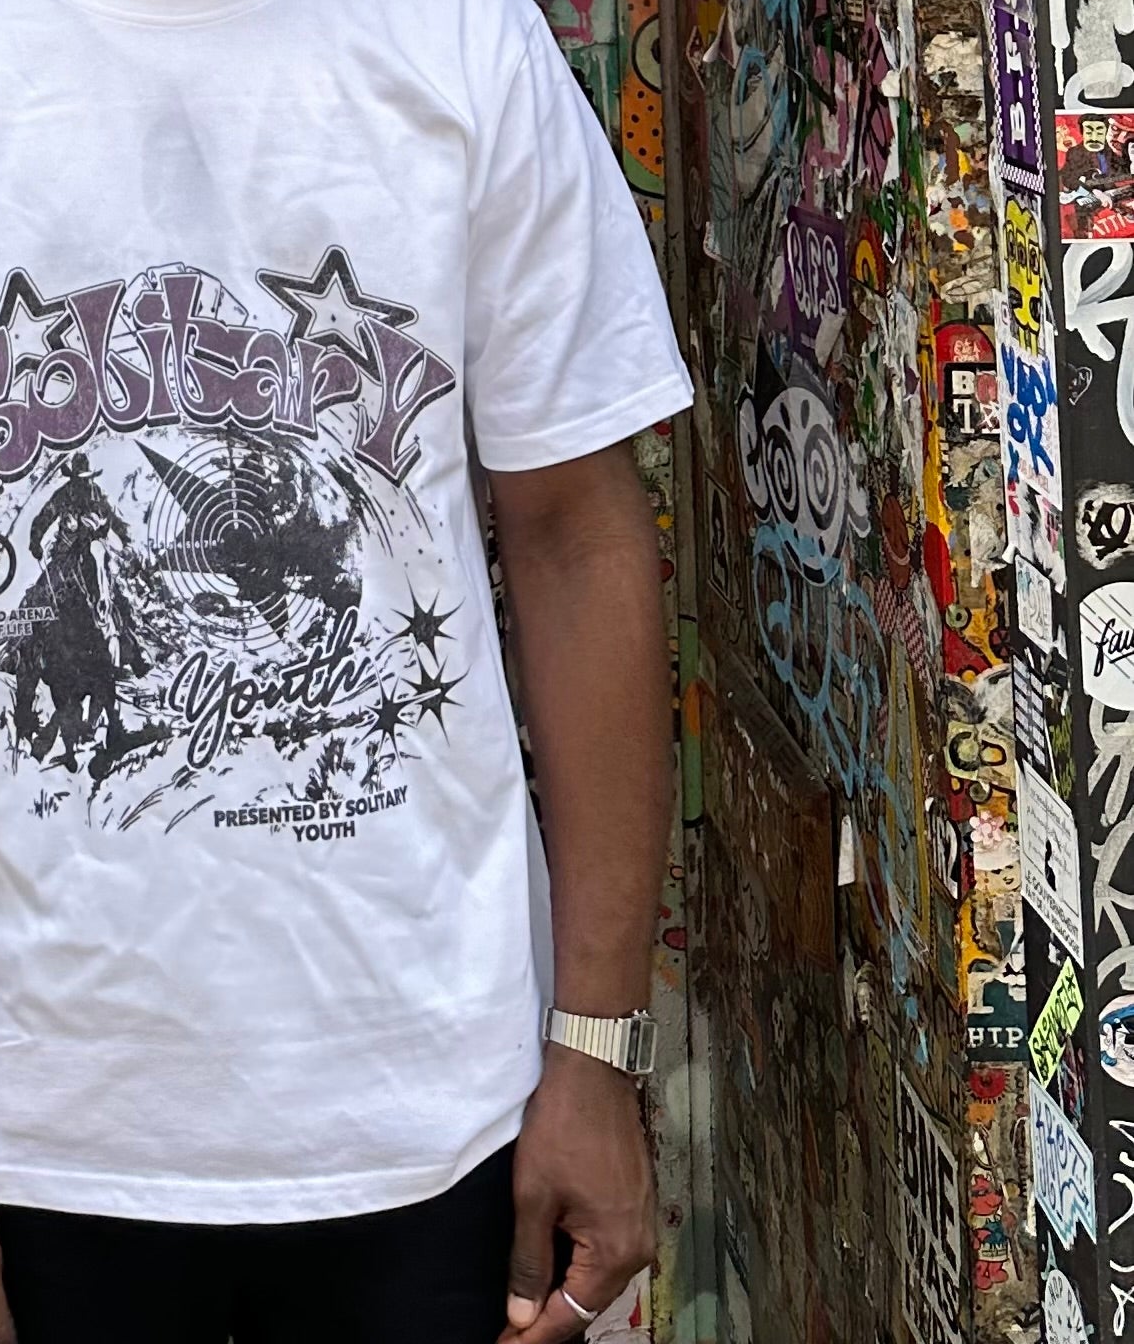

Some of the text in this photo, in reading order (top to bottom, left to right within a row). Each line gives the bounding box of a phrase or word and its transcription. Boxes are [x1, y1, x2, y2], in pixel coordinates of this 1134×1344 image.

[8, 605, 54, 622] ARENA
[6, 621, 33, 636] LIFE
[213, 784, 408, 828] PRESENTED BY SOLITARY
[292, 820, 356, 843] YOUTH
